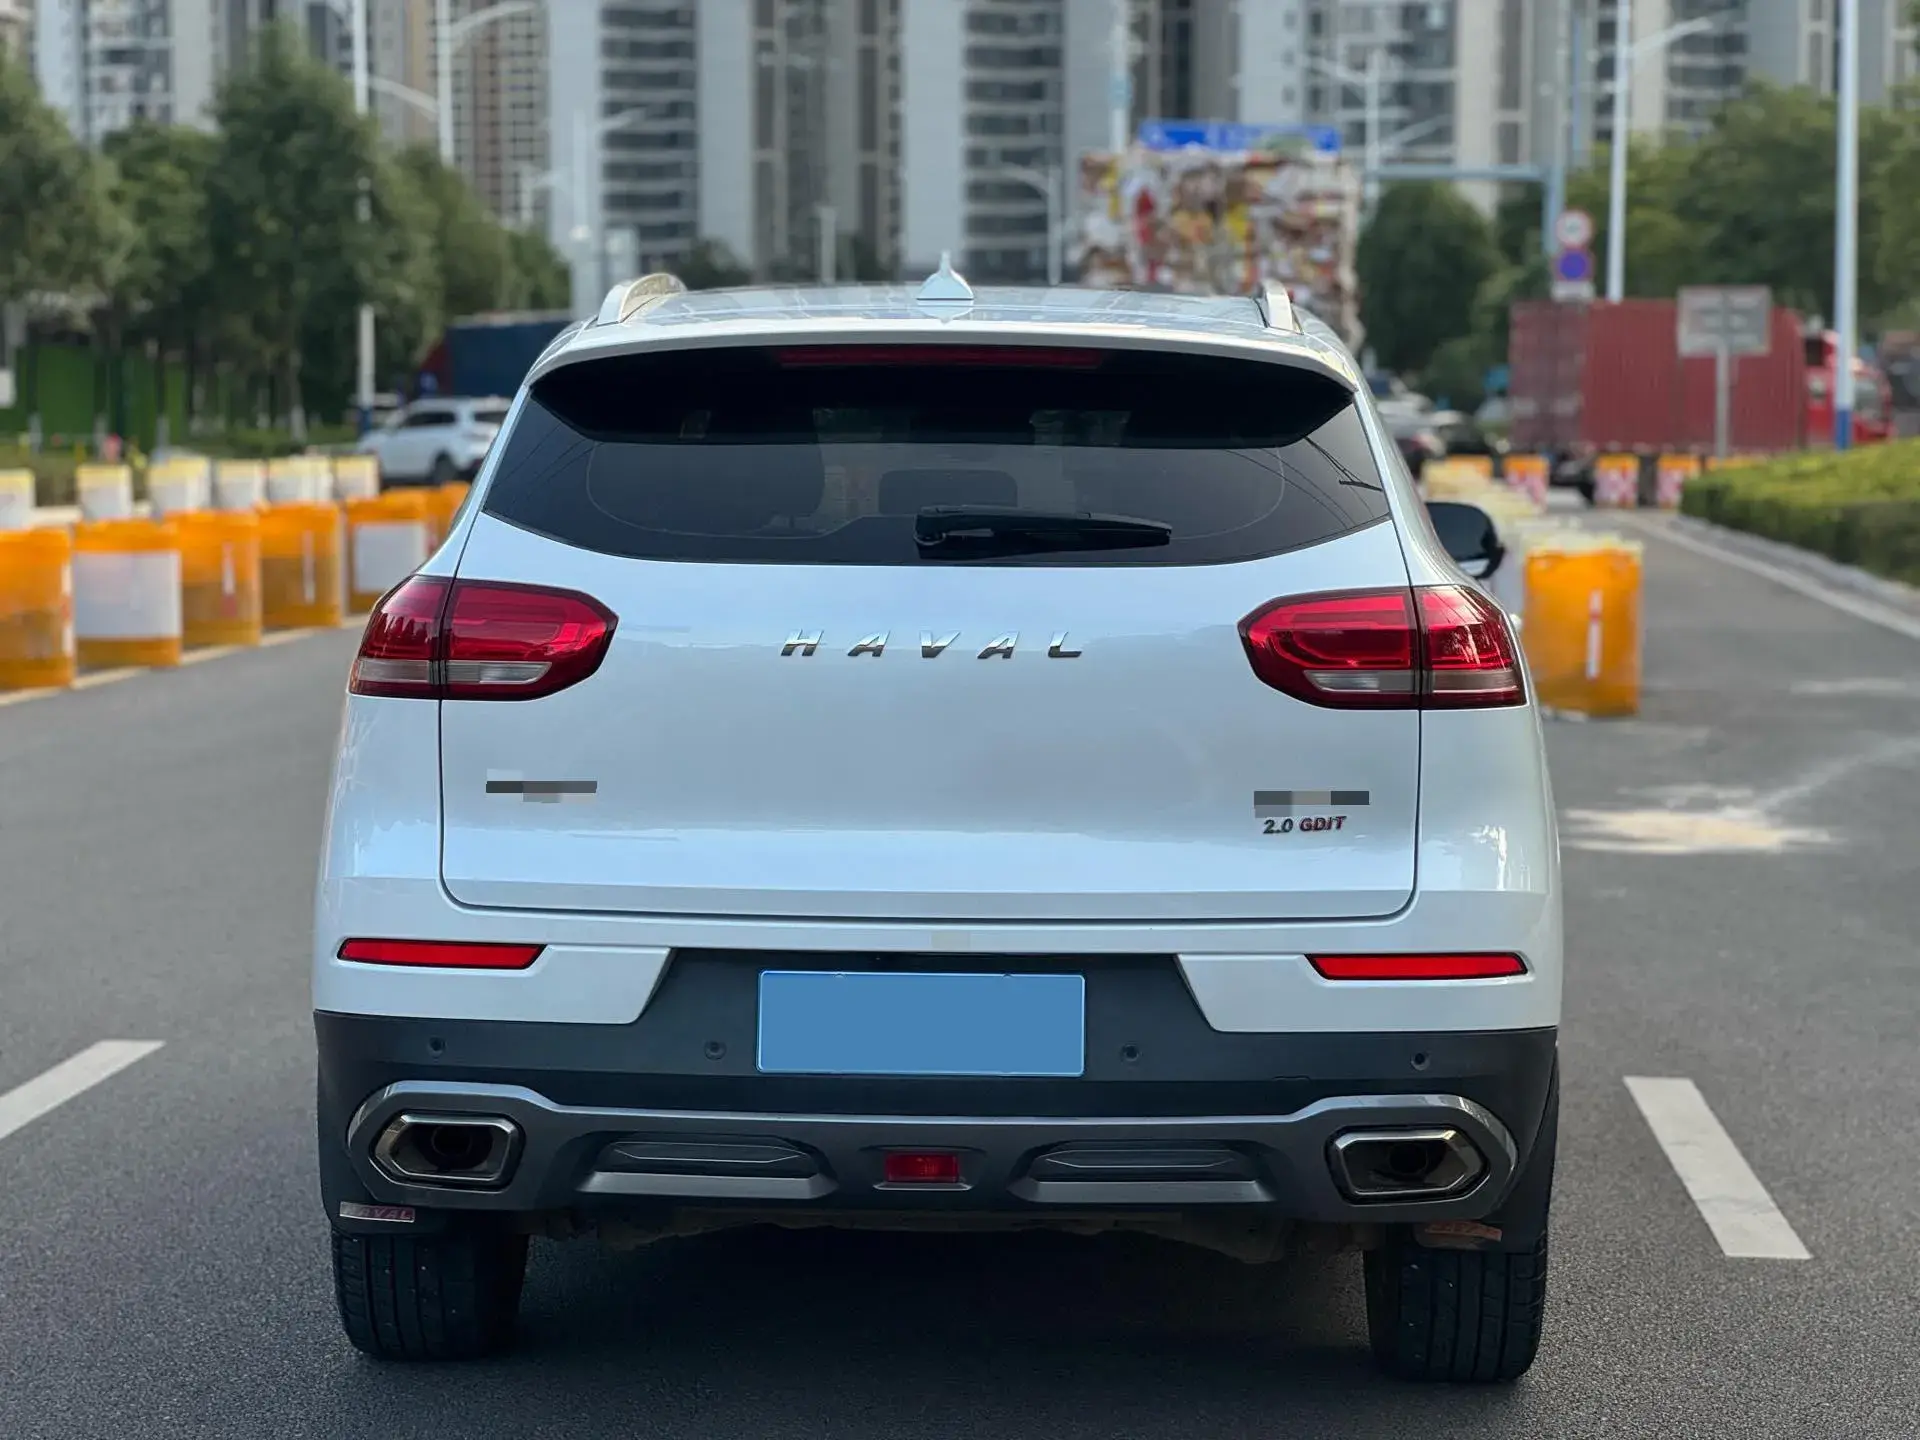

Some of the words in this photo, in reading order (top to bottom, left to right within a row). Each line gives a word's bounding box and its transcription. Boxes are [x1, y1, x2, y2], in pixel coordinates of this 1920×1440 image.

[781, 630, 1082, 659] HAVAL
[1263, 818, 1293, 834] 2.0
[1299, 816, 1347, 832] GDIT
[343, 1204, 412, 1220] AVAL
